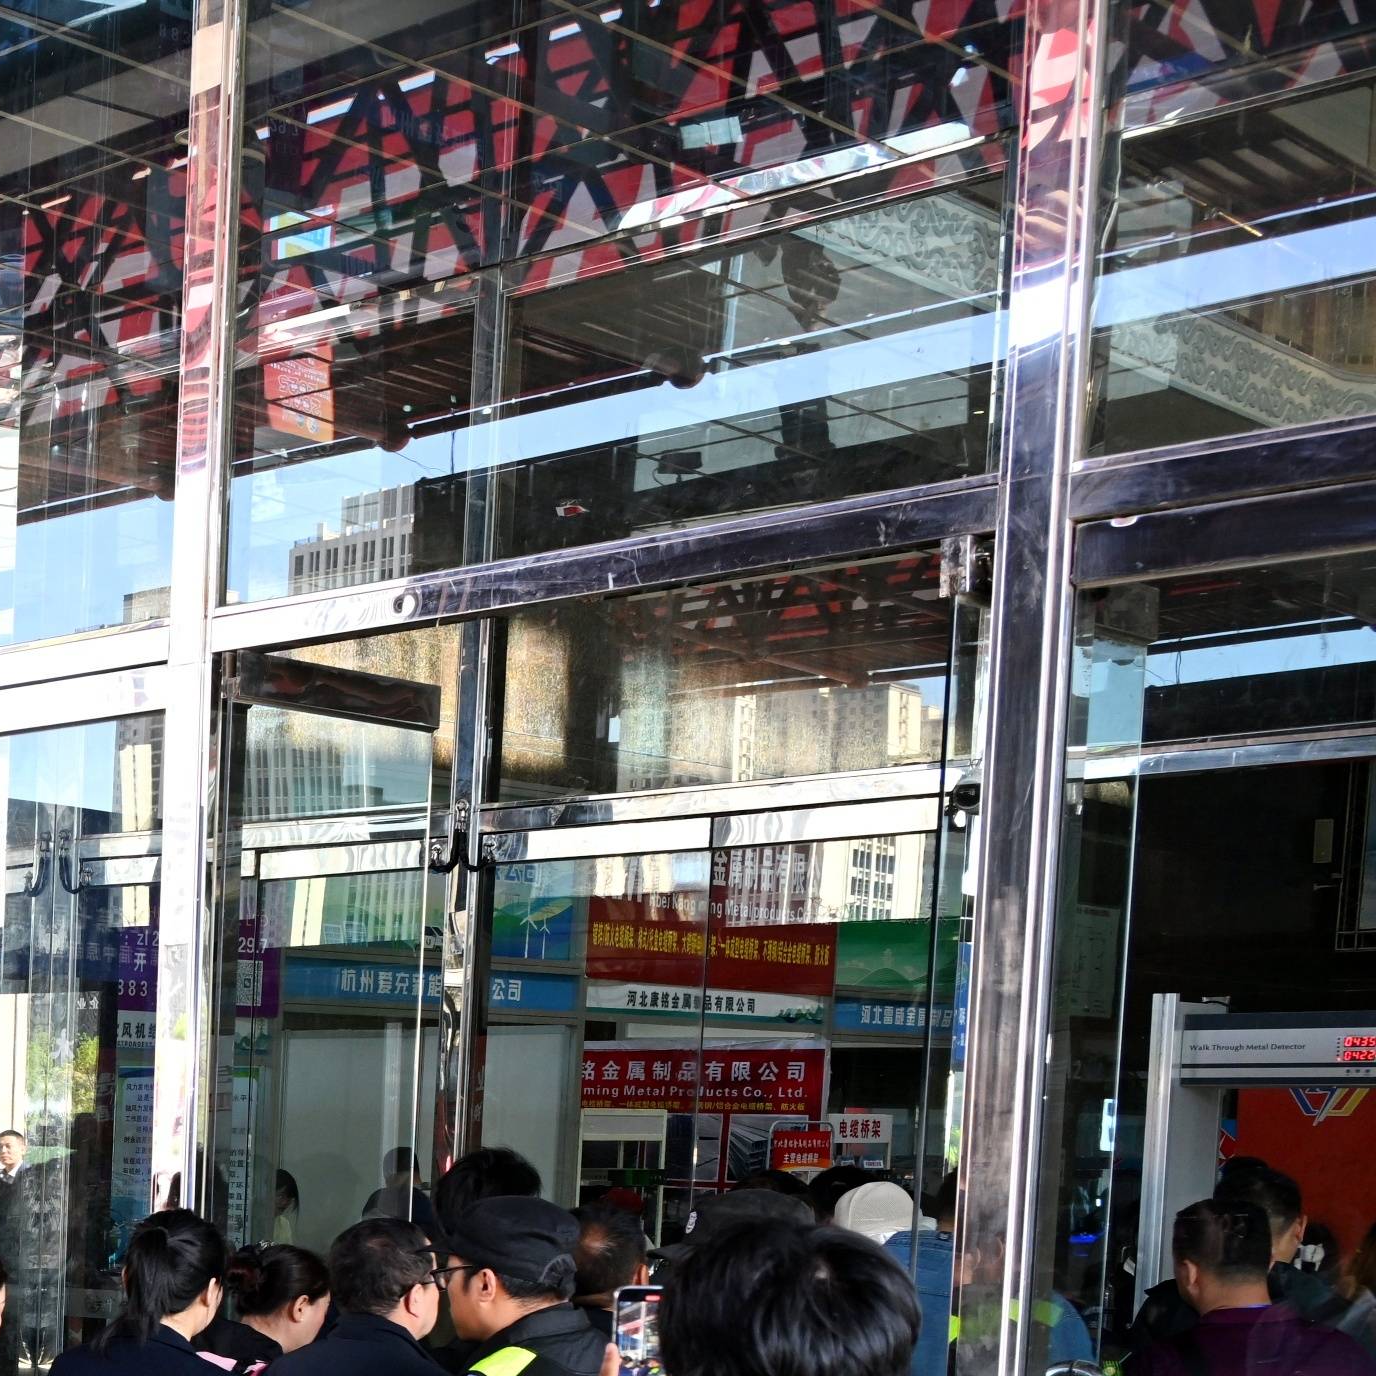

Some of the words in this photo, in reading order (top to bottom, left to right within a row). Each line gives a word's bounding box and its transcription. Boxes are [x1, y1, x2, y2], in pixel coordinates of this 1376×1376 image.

[491, 979, 522, 1001] 公司
[1212, 1043, 1245, 1053] Through
[1246, 1043, 1269, 1051] Metal
[1270, 1043, 1306, 1051] Detector
[624, 1085, 665, 1097] Metal
[778, 1086, 808, 1098] Ltd.
[839, 1119, 881, 1139] 电缆桥架
